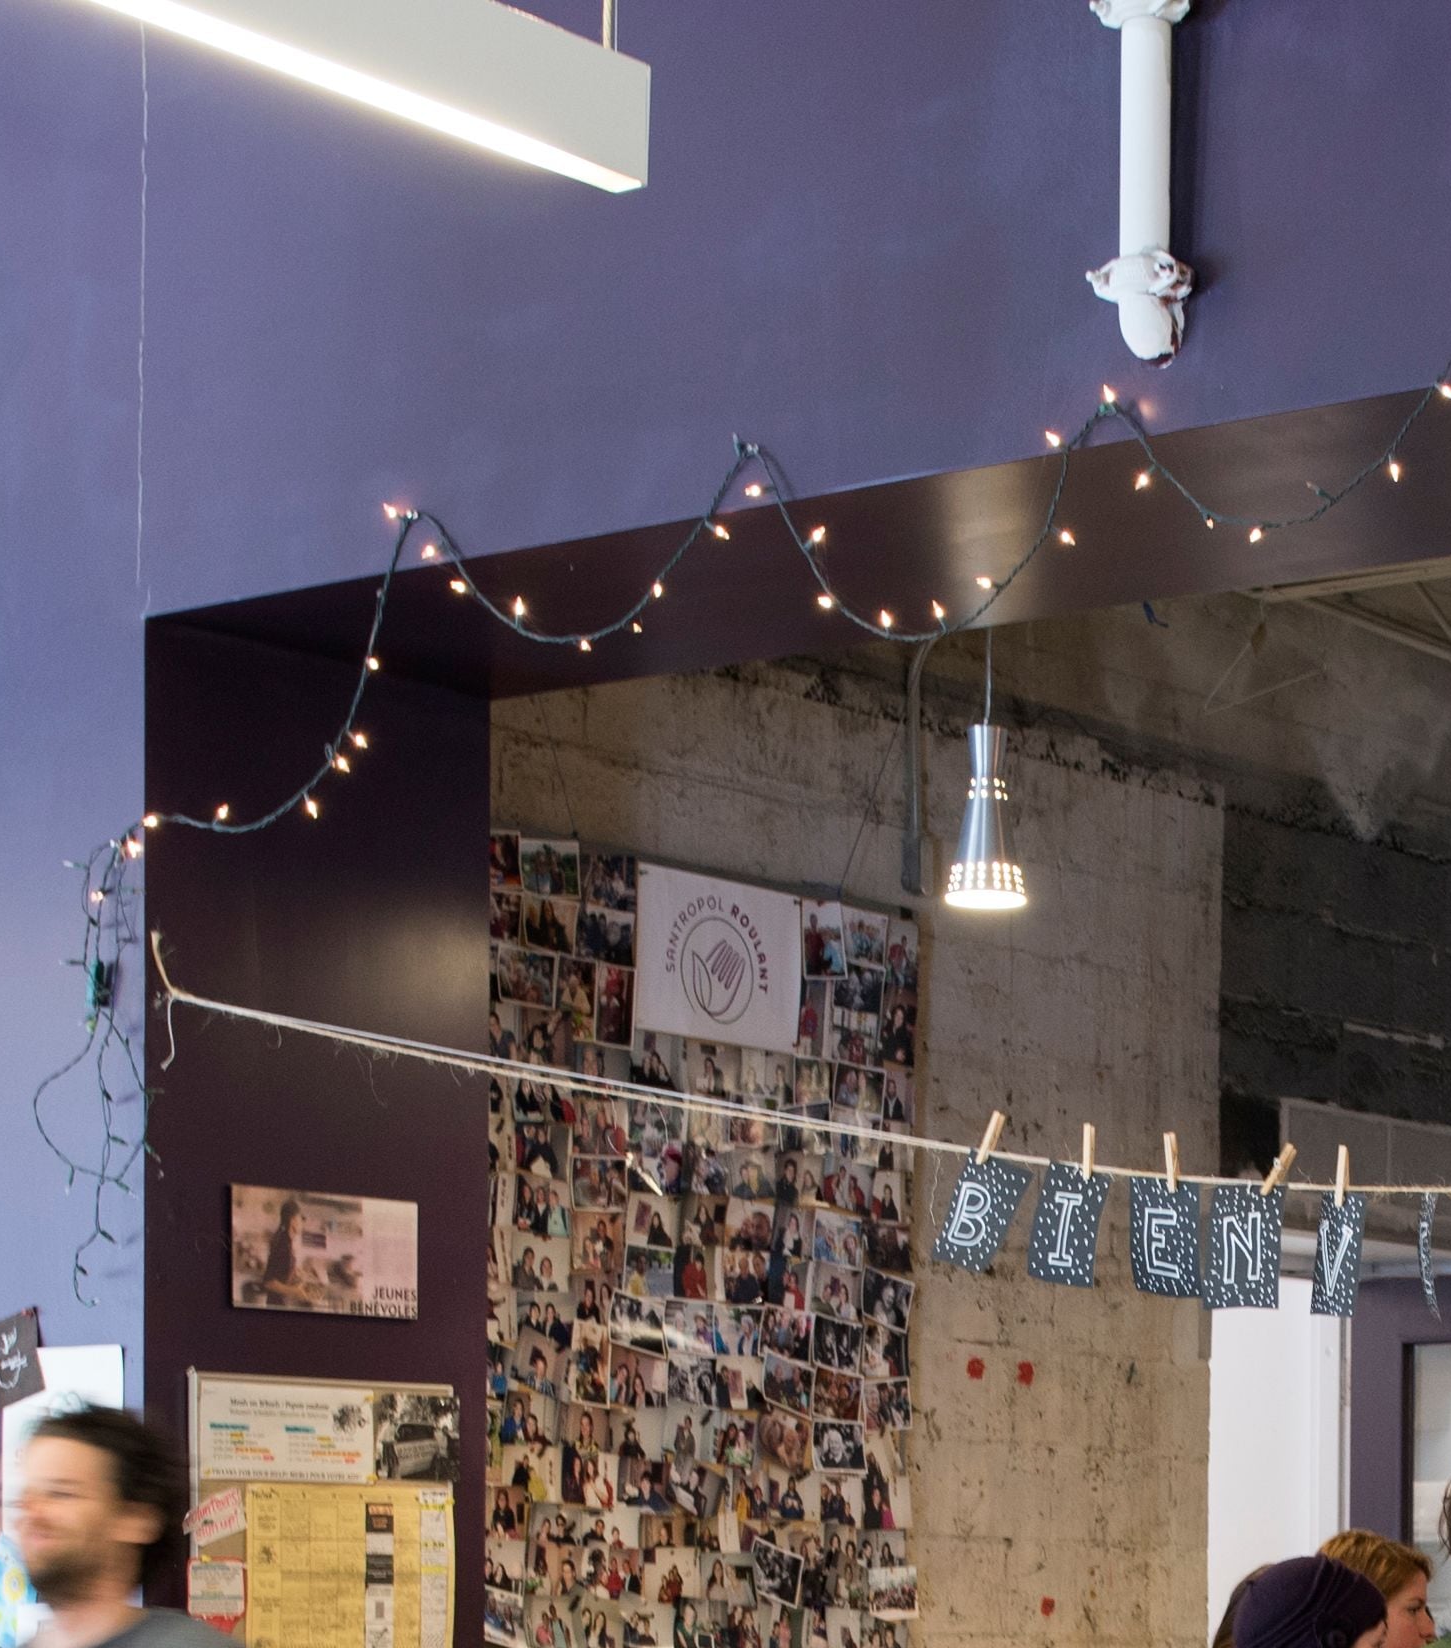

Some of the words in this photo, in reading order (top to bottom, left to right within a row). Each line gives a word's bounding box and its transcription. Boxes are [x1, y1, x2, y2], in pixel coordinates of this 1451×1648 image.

[665, 895, 726, 974] SANTROPOL
[731, 904, 769, 994] ROULANT
[372, 1286, 417, 1301] JEUNES
